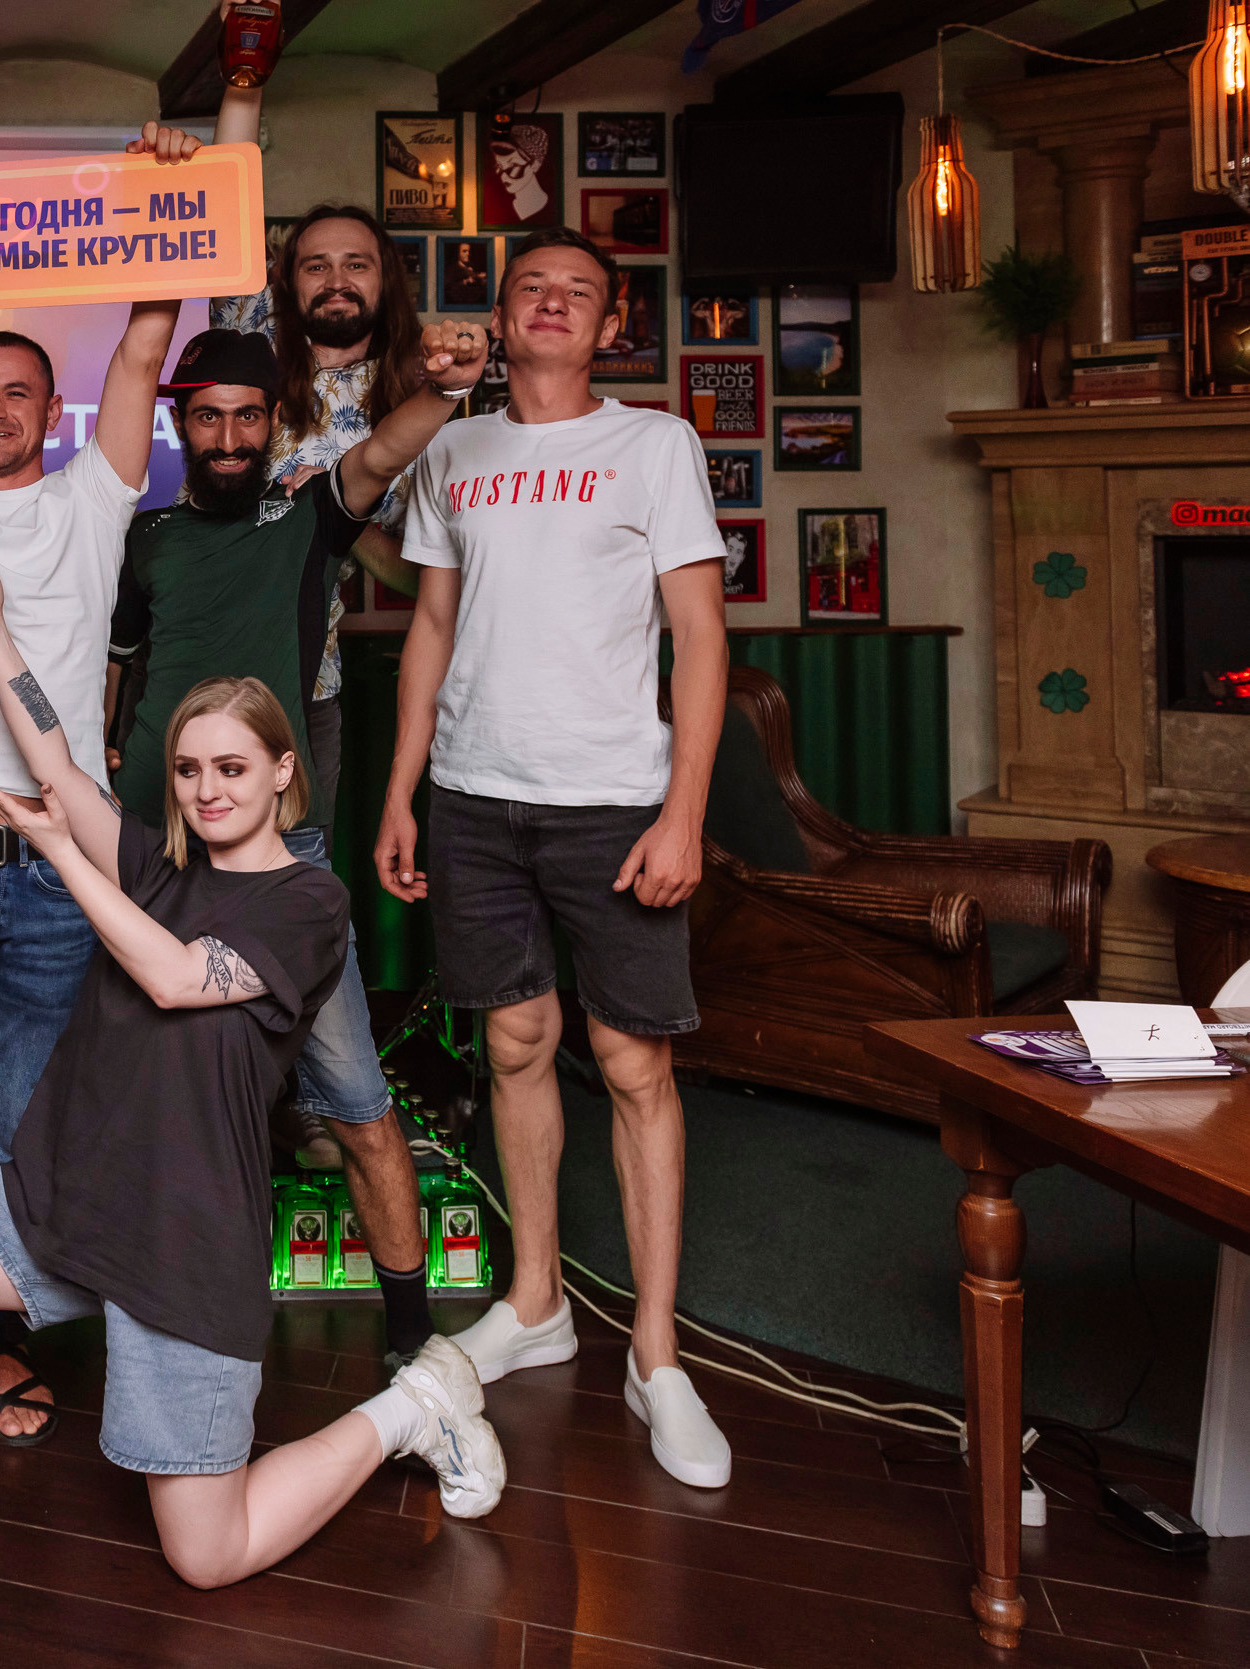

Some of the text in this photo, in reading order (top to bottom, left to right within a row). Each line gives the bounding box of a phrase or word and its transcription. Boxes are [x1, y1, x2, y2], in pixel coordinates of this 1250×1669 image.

[390, 189, 428, 206] ПИВО
[149, 190, 206, 223] МЫ
[1195, 229, 1249, 246] DOUBLE
[77, 229, 217, 265] КРУТЫЕ!
[691, 363, 754, 375] DRINK
[691, 375, 754, 388] GOOD
[717, 389, 755, 401] BEER
[715, 411, 756, 421] GOOD
[715, 421, 756, 432] FRIENDS
[449, 469, 598, 516] MUSTANG
[1203, 508, 1250, 522] ma
